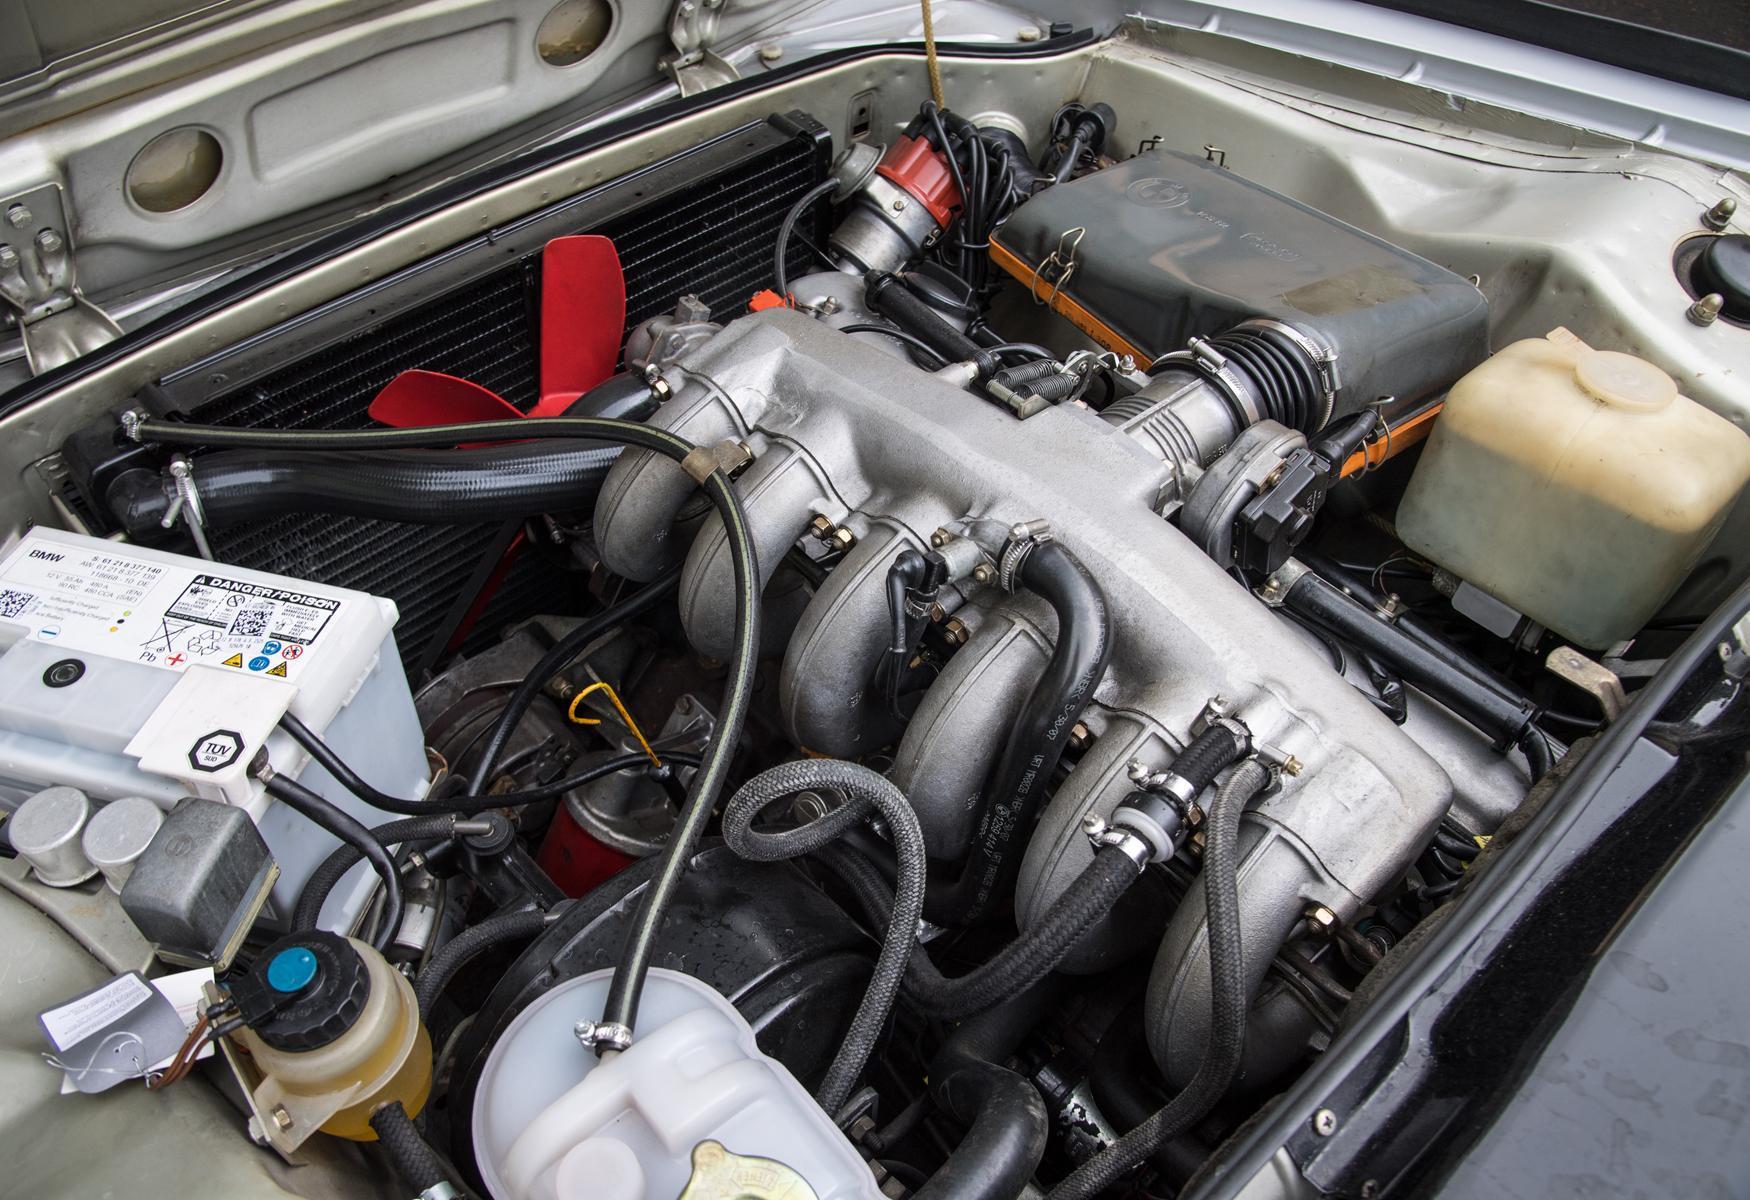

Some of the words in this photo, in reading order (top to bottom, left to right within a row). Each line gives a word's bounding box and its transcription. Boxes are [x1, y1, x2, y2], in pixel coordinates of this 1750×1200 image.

[29, 549, 65, 562] BMW
[210, 577, 340, 610] DANGER/POISON
[139, 651, 156, 662] Pb
[990, 815, 1004, 835] 1259
